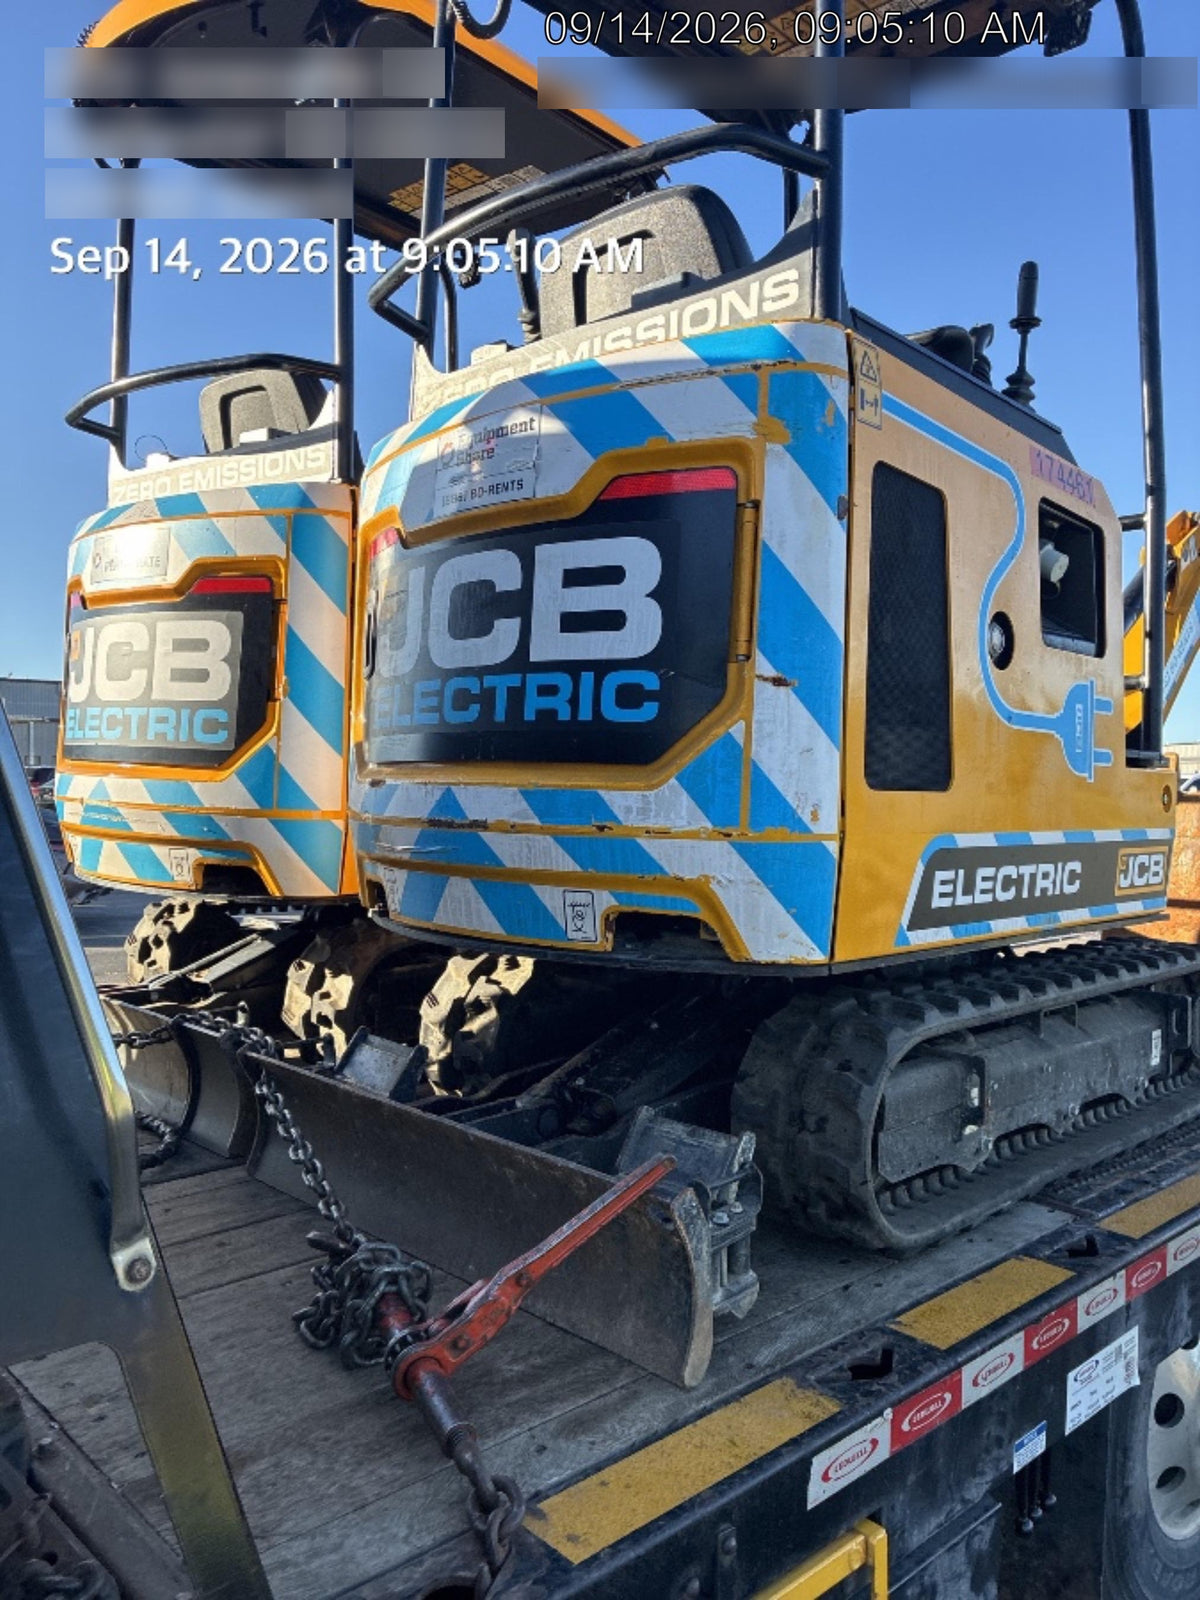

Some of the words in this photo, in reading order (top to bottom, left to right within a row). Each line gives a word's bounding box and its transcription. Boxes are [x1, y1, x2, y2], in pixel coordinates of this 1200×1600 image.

[530, 270, 799, 371] EMISSIONS
[179, 447, 325, 492] EMISSIONS
[377, 536, 662, 678] JCB
[70, 620, 232, 703] JCB
[66, 706, 229, 744] ELECTRIC
[373, 669, 661, 729] ELECTRIC
[931, 861, 1082, 909] ELECTRIC
[1119, 853, 1165, 888] JCB
